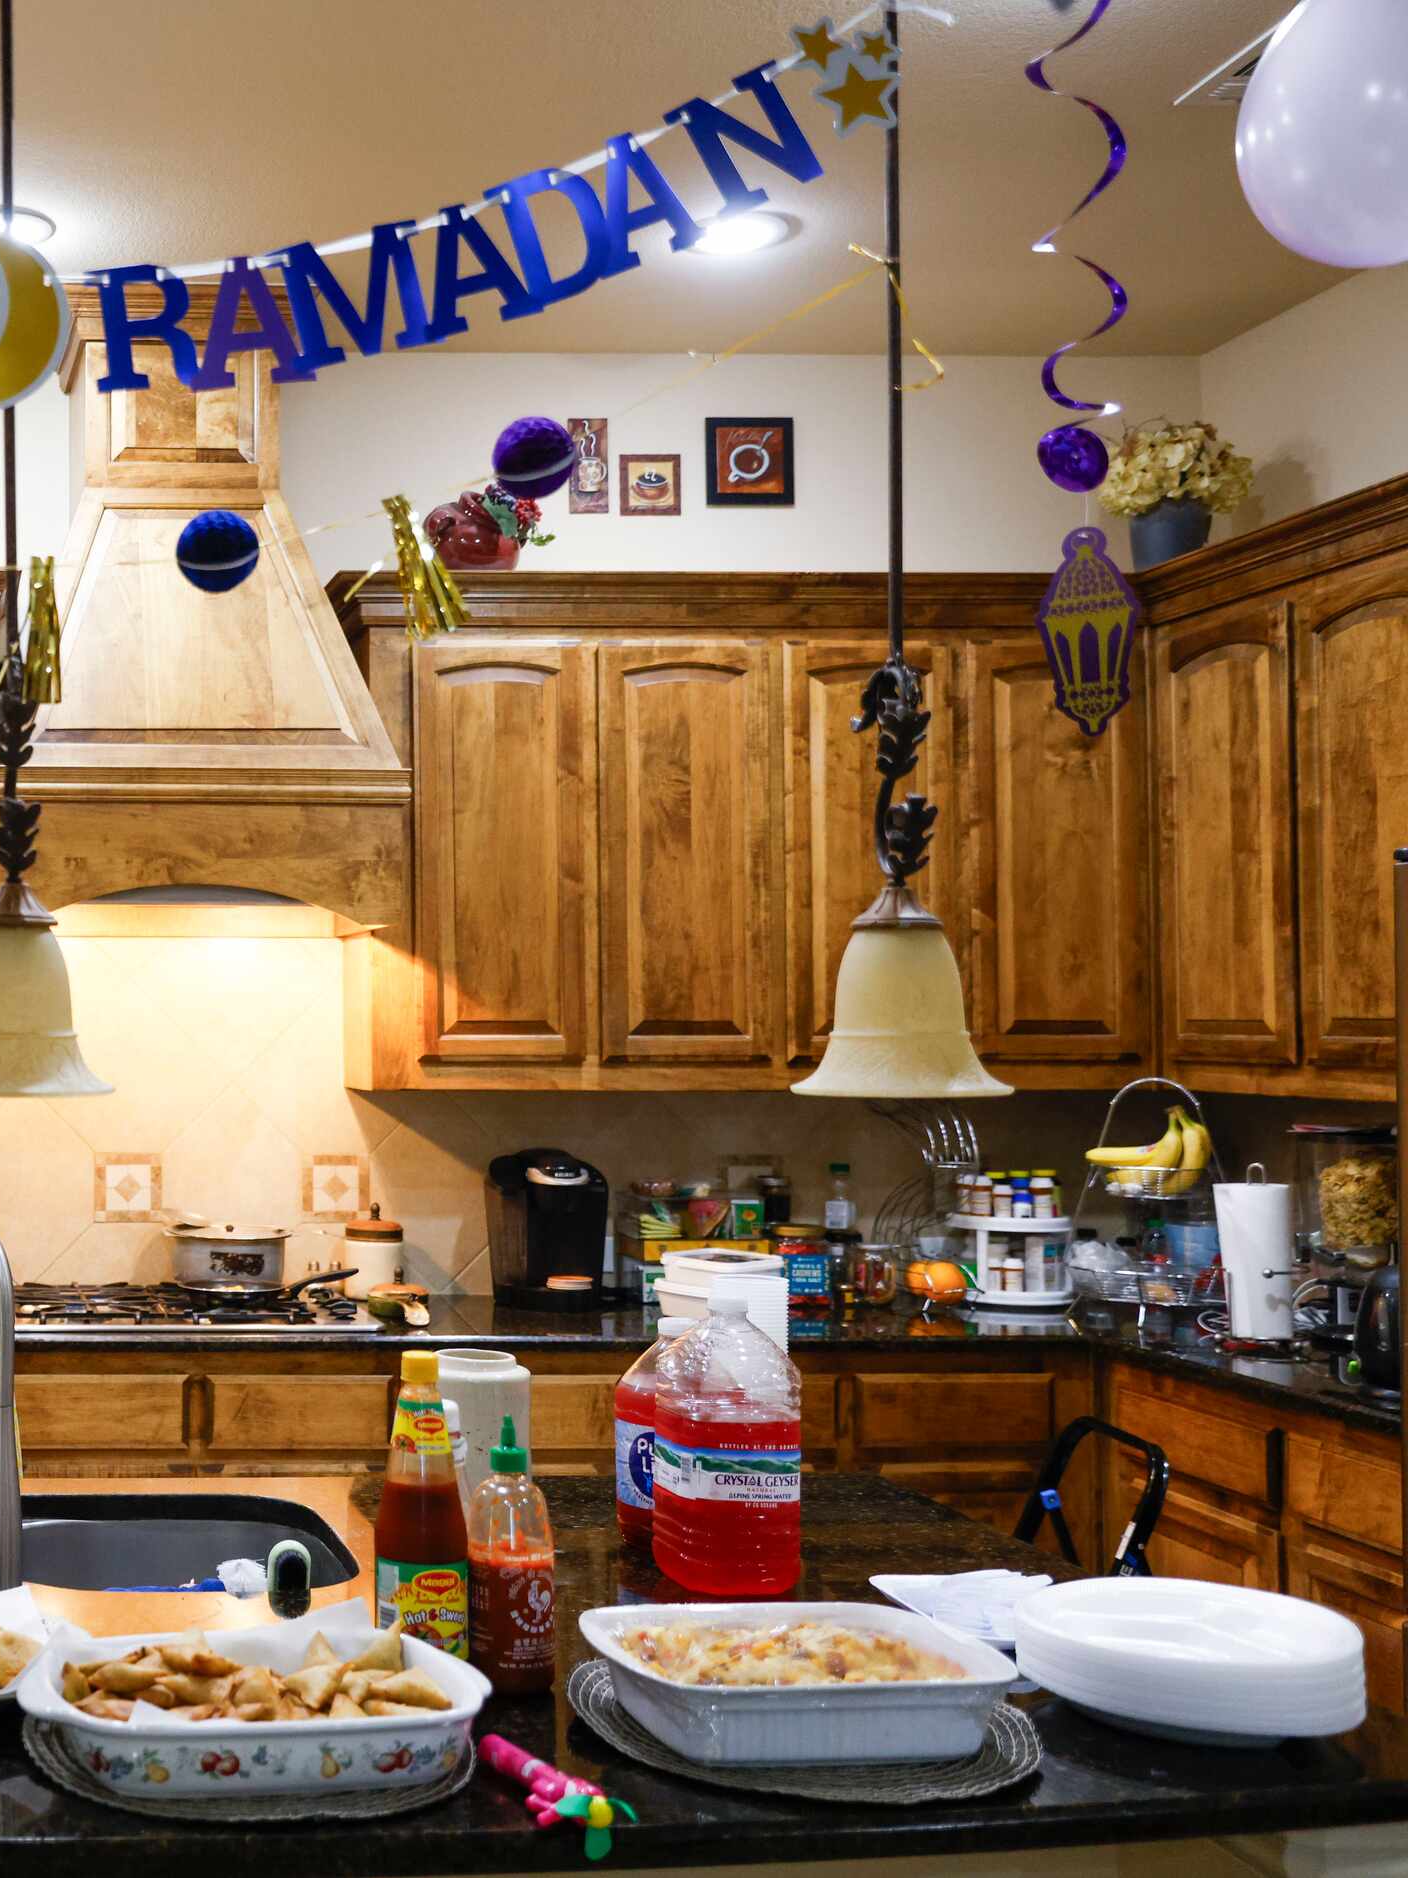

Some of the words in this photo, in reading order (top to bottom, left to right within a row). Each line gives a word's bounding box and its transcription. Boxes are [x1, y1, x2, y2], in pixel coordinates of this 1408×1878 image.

[85, 60, 824, 393] RAMADAN
[715, 1474, 763, 1487] CRYSTAL
[764, 1475, 799, 1488] GEYSER
[403, 1610, 427, 1625] Hot
